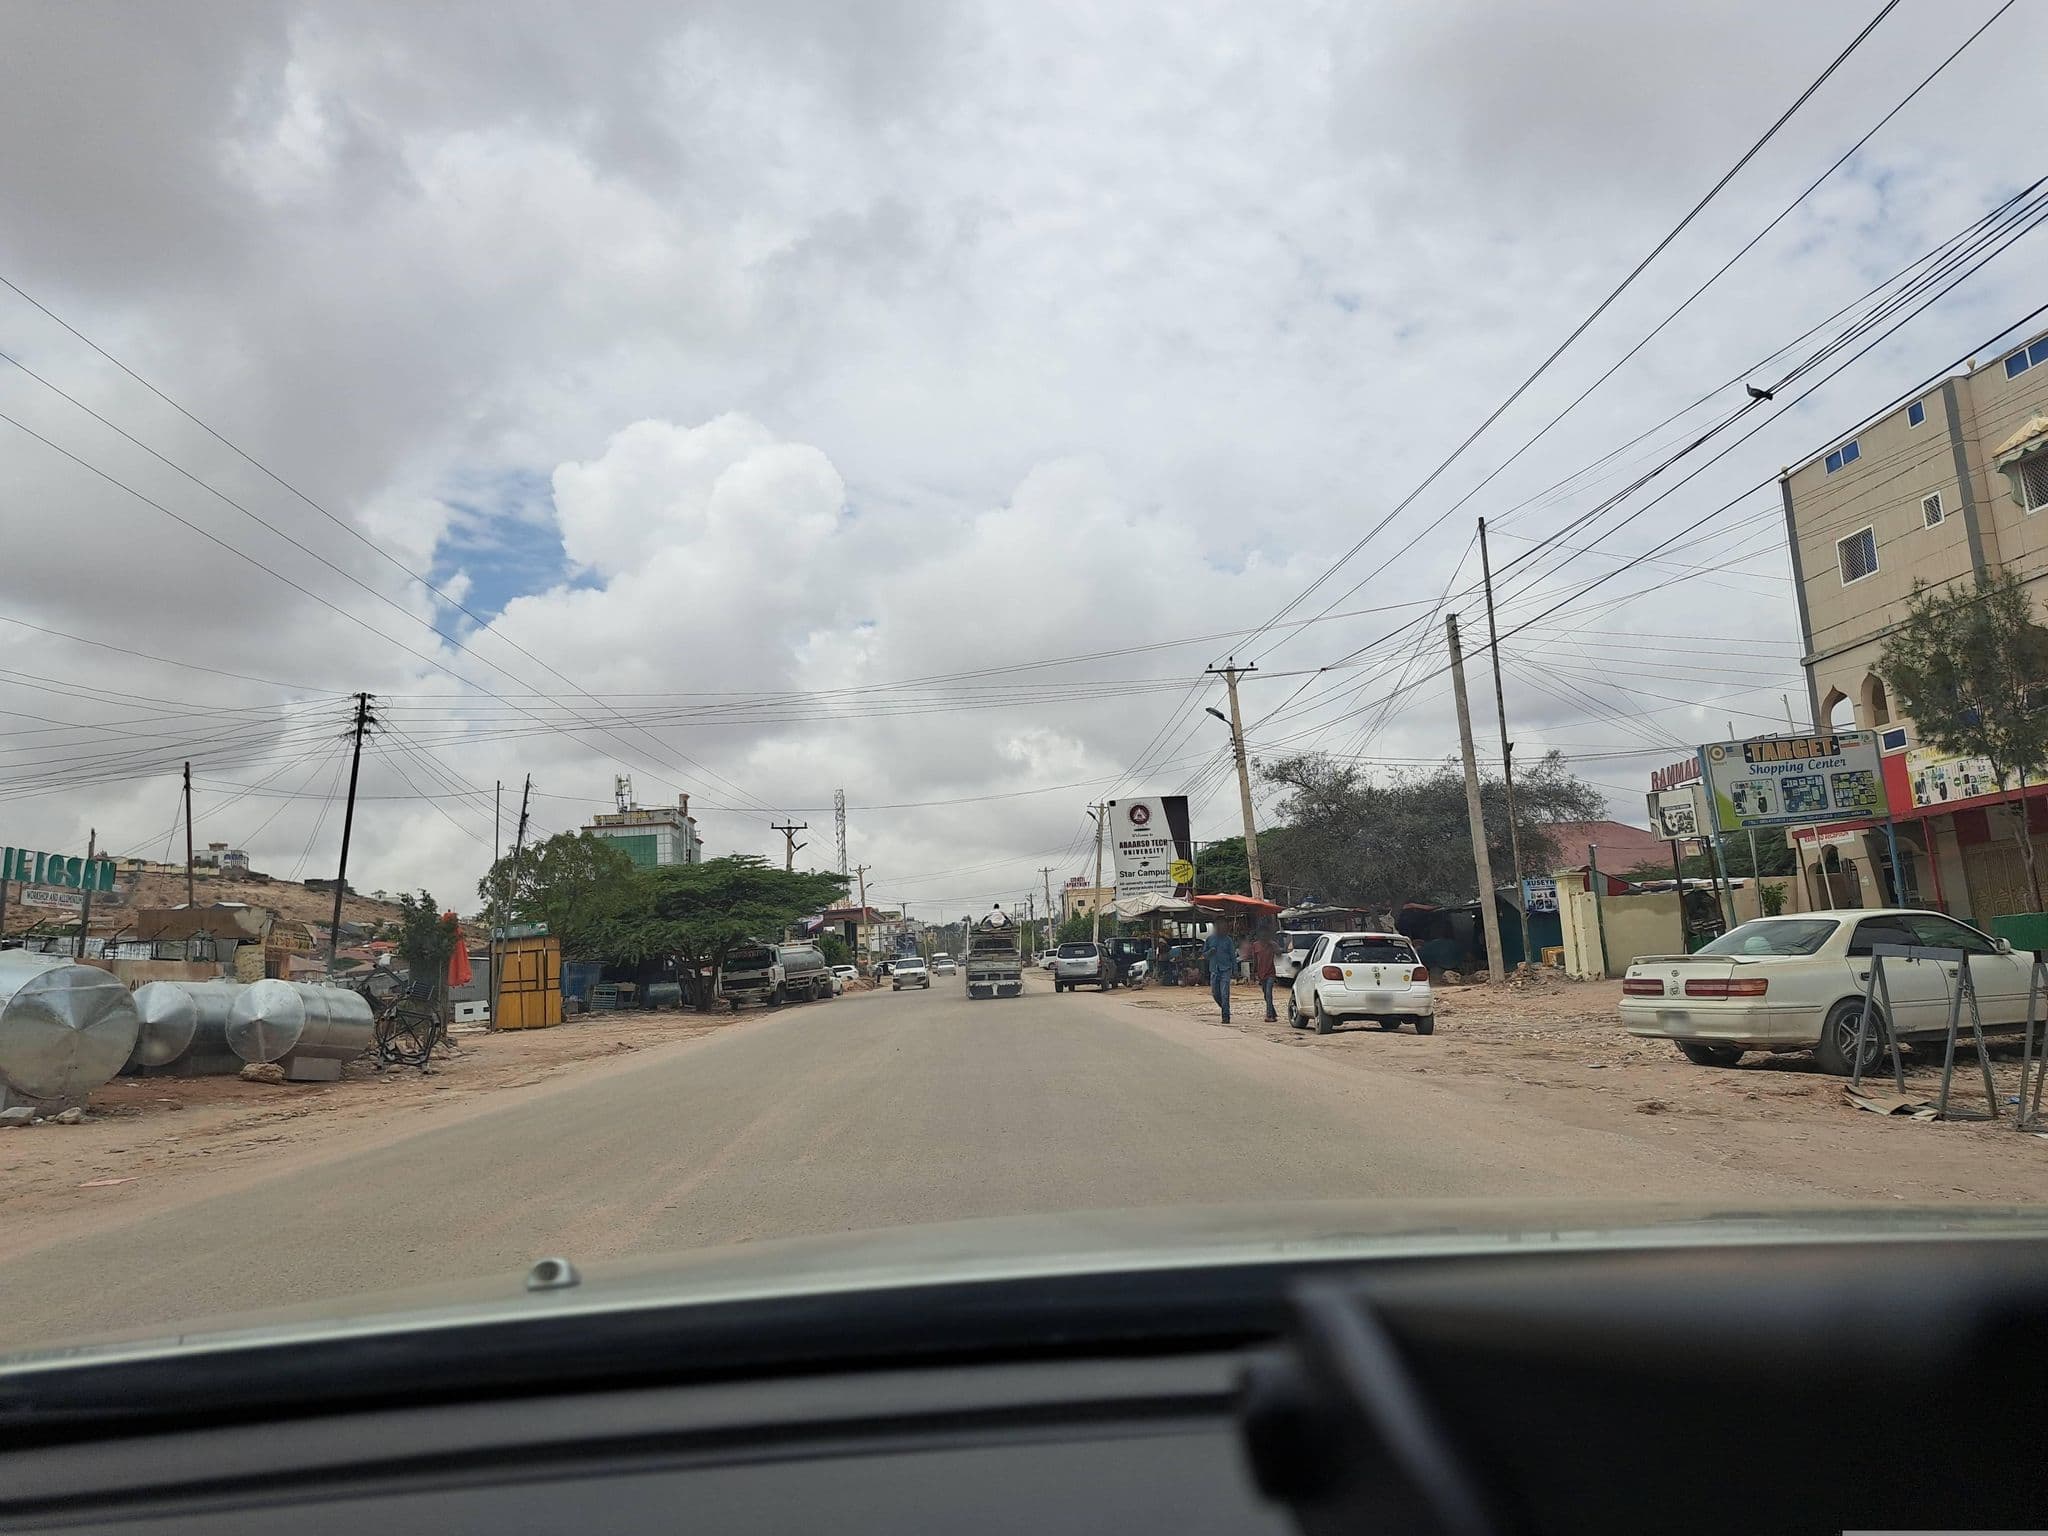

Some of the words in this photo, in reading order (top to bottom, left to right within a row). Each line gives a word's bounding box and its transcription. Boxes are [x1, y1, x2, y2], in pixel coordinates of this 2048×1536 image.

[1749, 736, 1834, 763] TARGET
[1749, 762, 1804, 776] Shopping
[1807, 758, 1847, 770] Center
[1151, 838, 1168, 847] TECH
[1123, 847, 1165, 856] UNIVERSITY
[1120, 870, 1136, 878] Star
